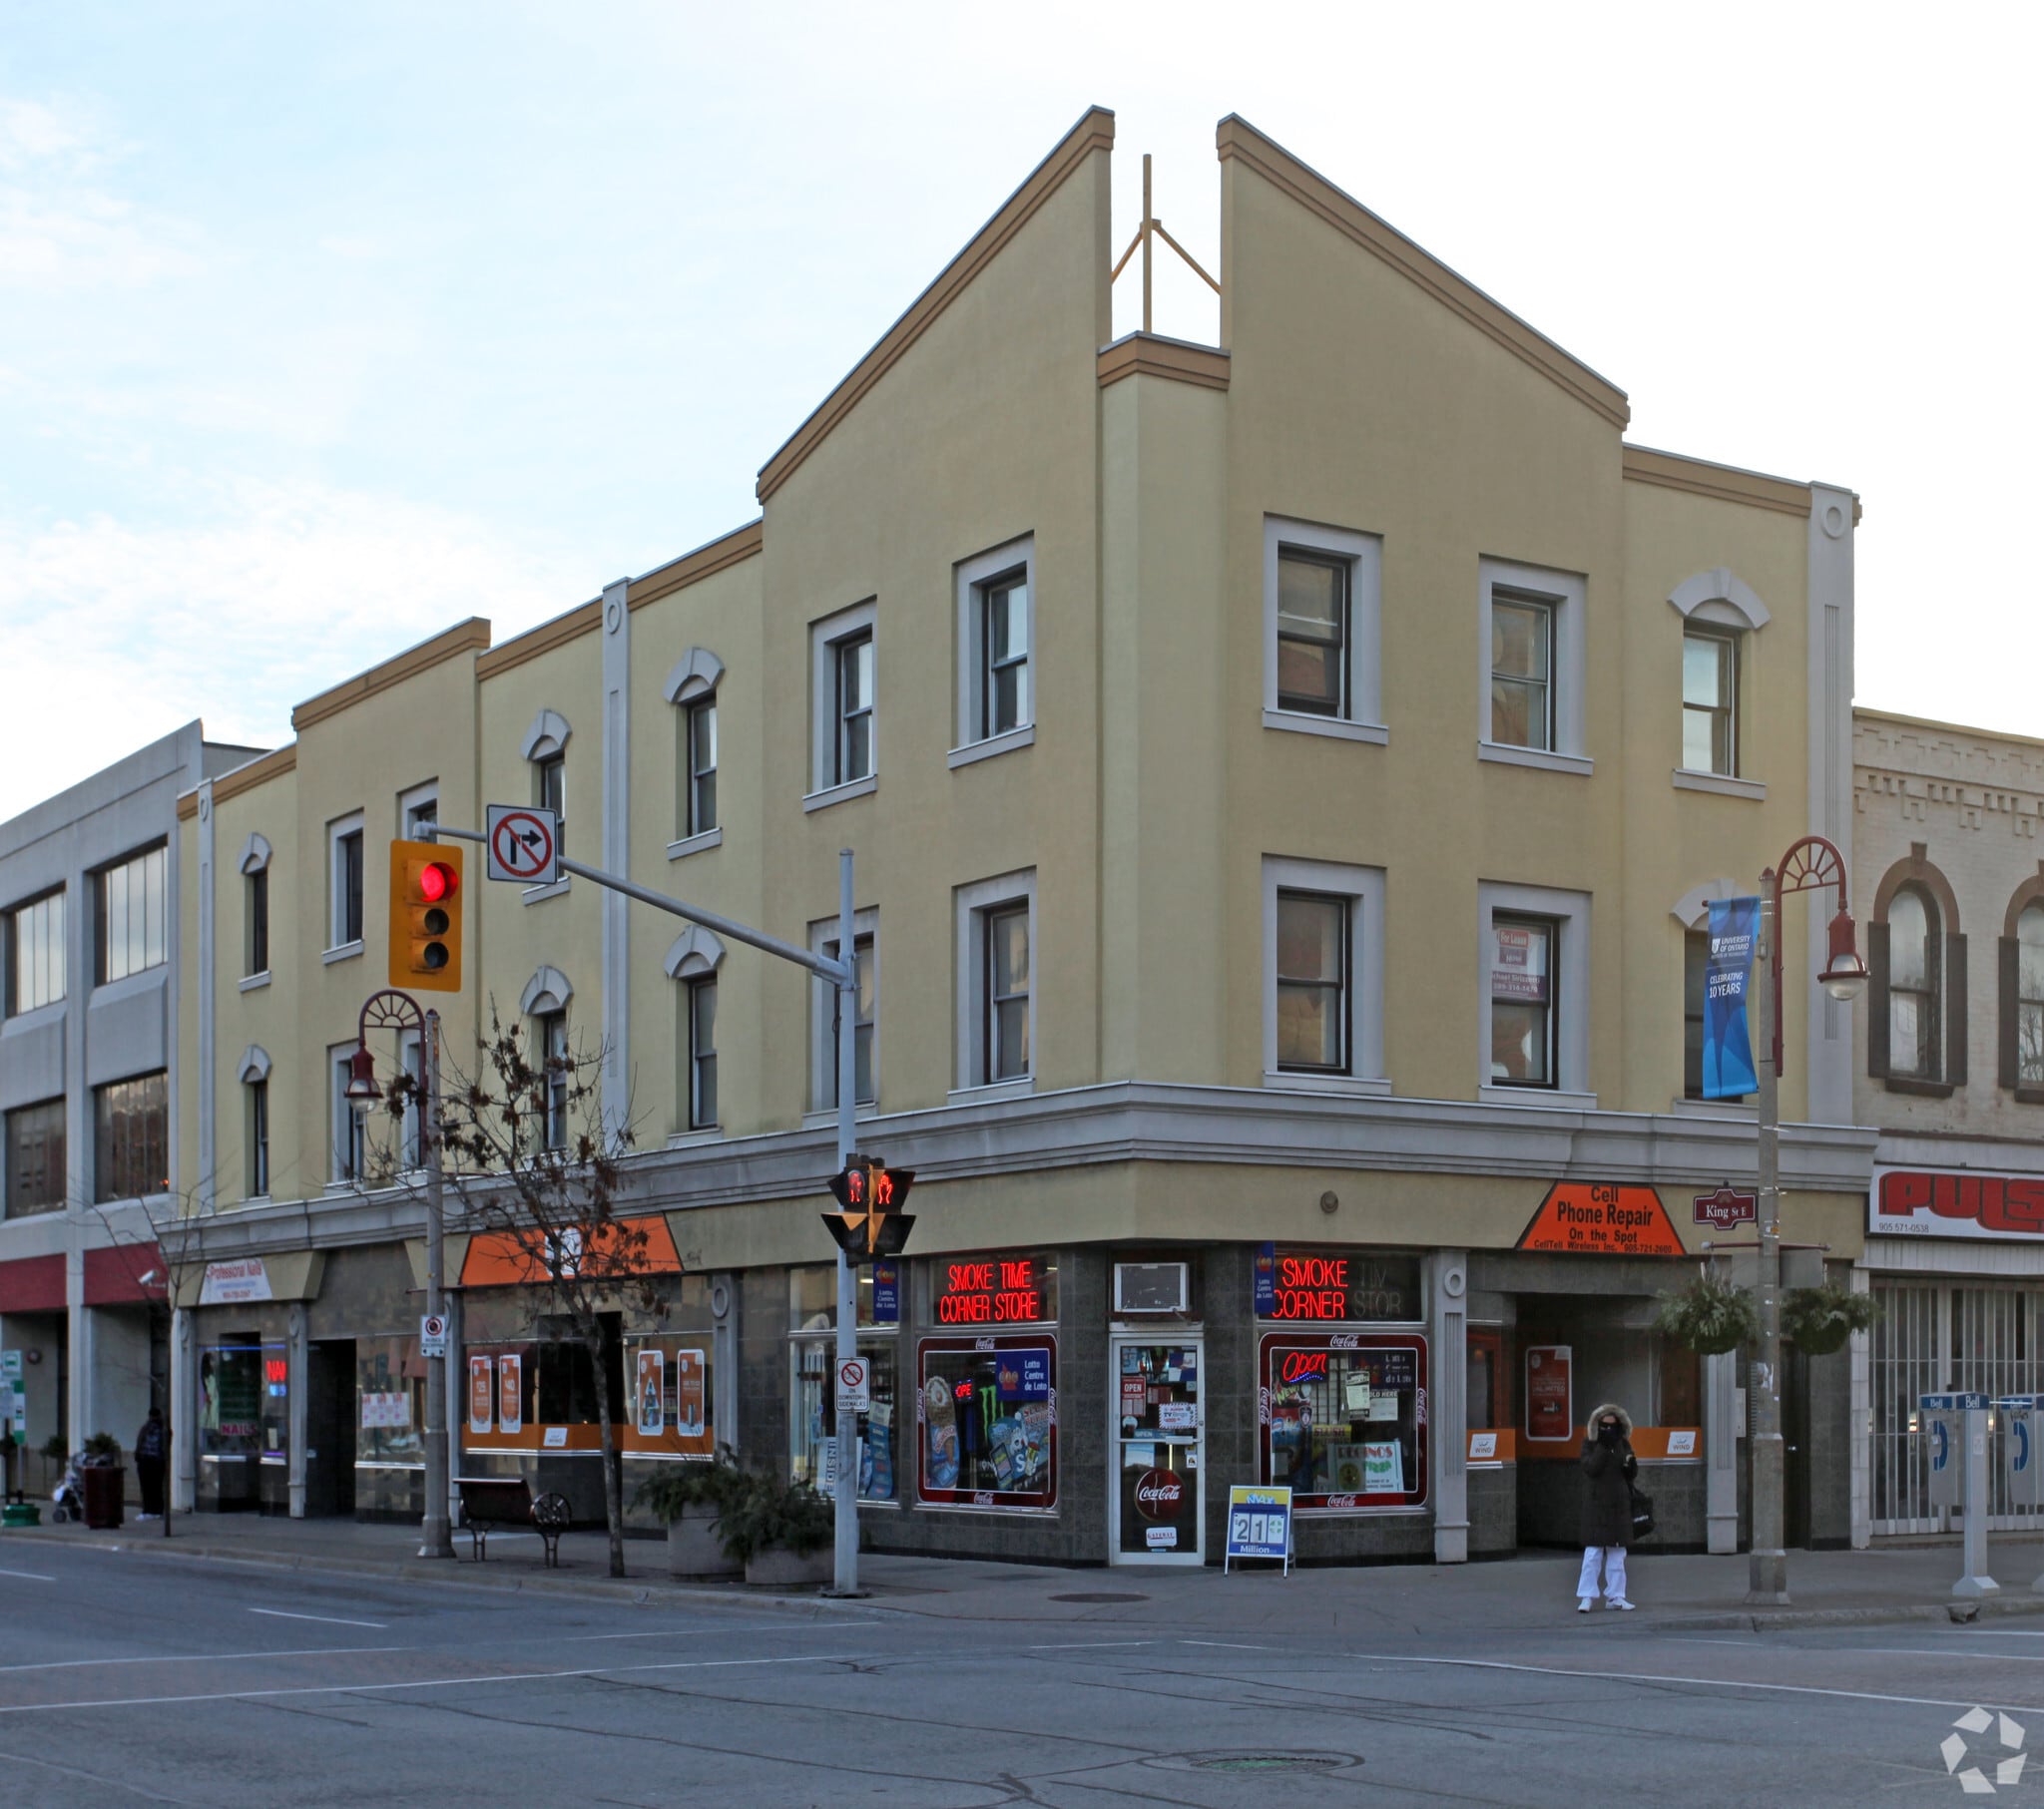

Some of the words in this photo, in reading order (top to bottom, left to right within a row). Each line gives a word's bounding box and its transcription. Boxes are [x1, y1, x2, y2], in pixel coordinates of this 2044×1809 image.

[1721, 935, 1752, 946] UNIVERSITY
[1720, 944, 1728, 953] OF
[1728, 943, 1750, 952] ONTARIO
[1710, 972, 1744, 985] CELEBRATING
[1710, 986, 1718, 999] 10
[1718, 982, 1742, 997] YEARS
[1591, 1185, 1619, 1202] Cell
[1557, 1200, 1603, 1224] Phone
[1607, 1202, 1654, 1230] Repair
[1706, 1204, 1729, 1219] King
[1741, 1206, 1747, 1216] E
[1878, 1221, 1893, 1232] 905
[1894, 1223, 1929, 1233] 571-0538
[1569, 1226, 1584, 1240] On
[1590, 1228, 1607, 1241] the
[1614, 1228, 1638, 1245] Spot
[1568, 1240, 1599, 1251] Wireless
[948, 1263, 994, 1292] SMOKE
[999, 1261, 1031, 1290] TIME
[1281, 1257, 1348, 1288] SMOKE
[940, 1294, 990, 1324] CORNER
[994, 1291, 1038, 1321] STORE
[1272, 1288, 1346, 1319] CORNER
[1024, 1359, 1040, 1370] Lotto
[1282, 1351, 1327, 1383] Open
[1024, 1371, 1044, 1381] Centre
[1024, 1381, 1033, 1391] de
[1033, 1382, 1048, 1392] Loto
[1124, 1383, 1143, 1393] OPEN
[1929, 1398, 1943, 1408] Bell
[1965, 1395, 1980, 1409] Bell
[1240, 1545, 1270, 1554] Million
